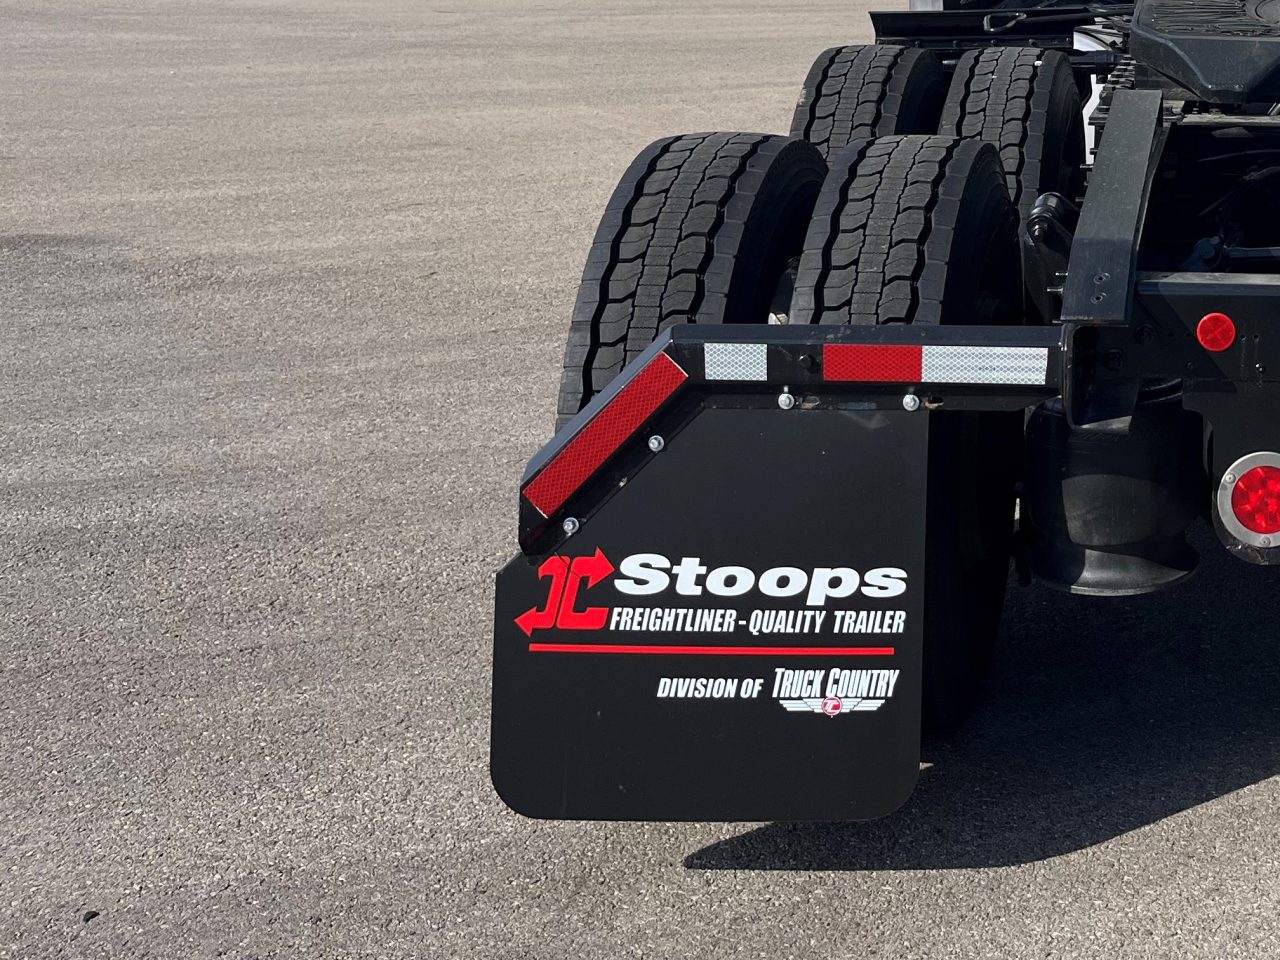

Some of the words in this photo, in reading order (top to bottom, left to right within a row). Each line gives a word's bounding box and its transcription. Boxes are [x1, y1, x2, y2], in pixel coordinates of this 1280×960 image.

[614, 553, 907, 606] Stoops
[833, 610, 906, 634] TRAILER
[657, 677, 738, 699] DIVISION
[739, 678, 764, 699] OF
[771, 667, 826, 699] TRUCK
[825, 667, 900, 699] COUNTRY
